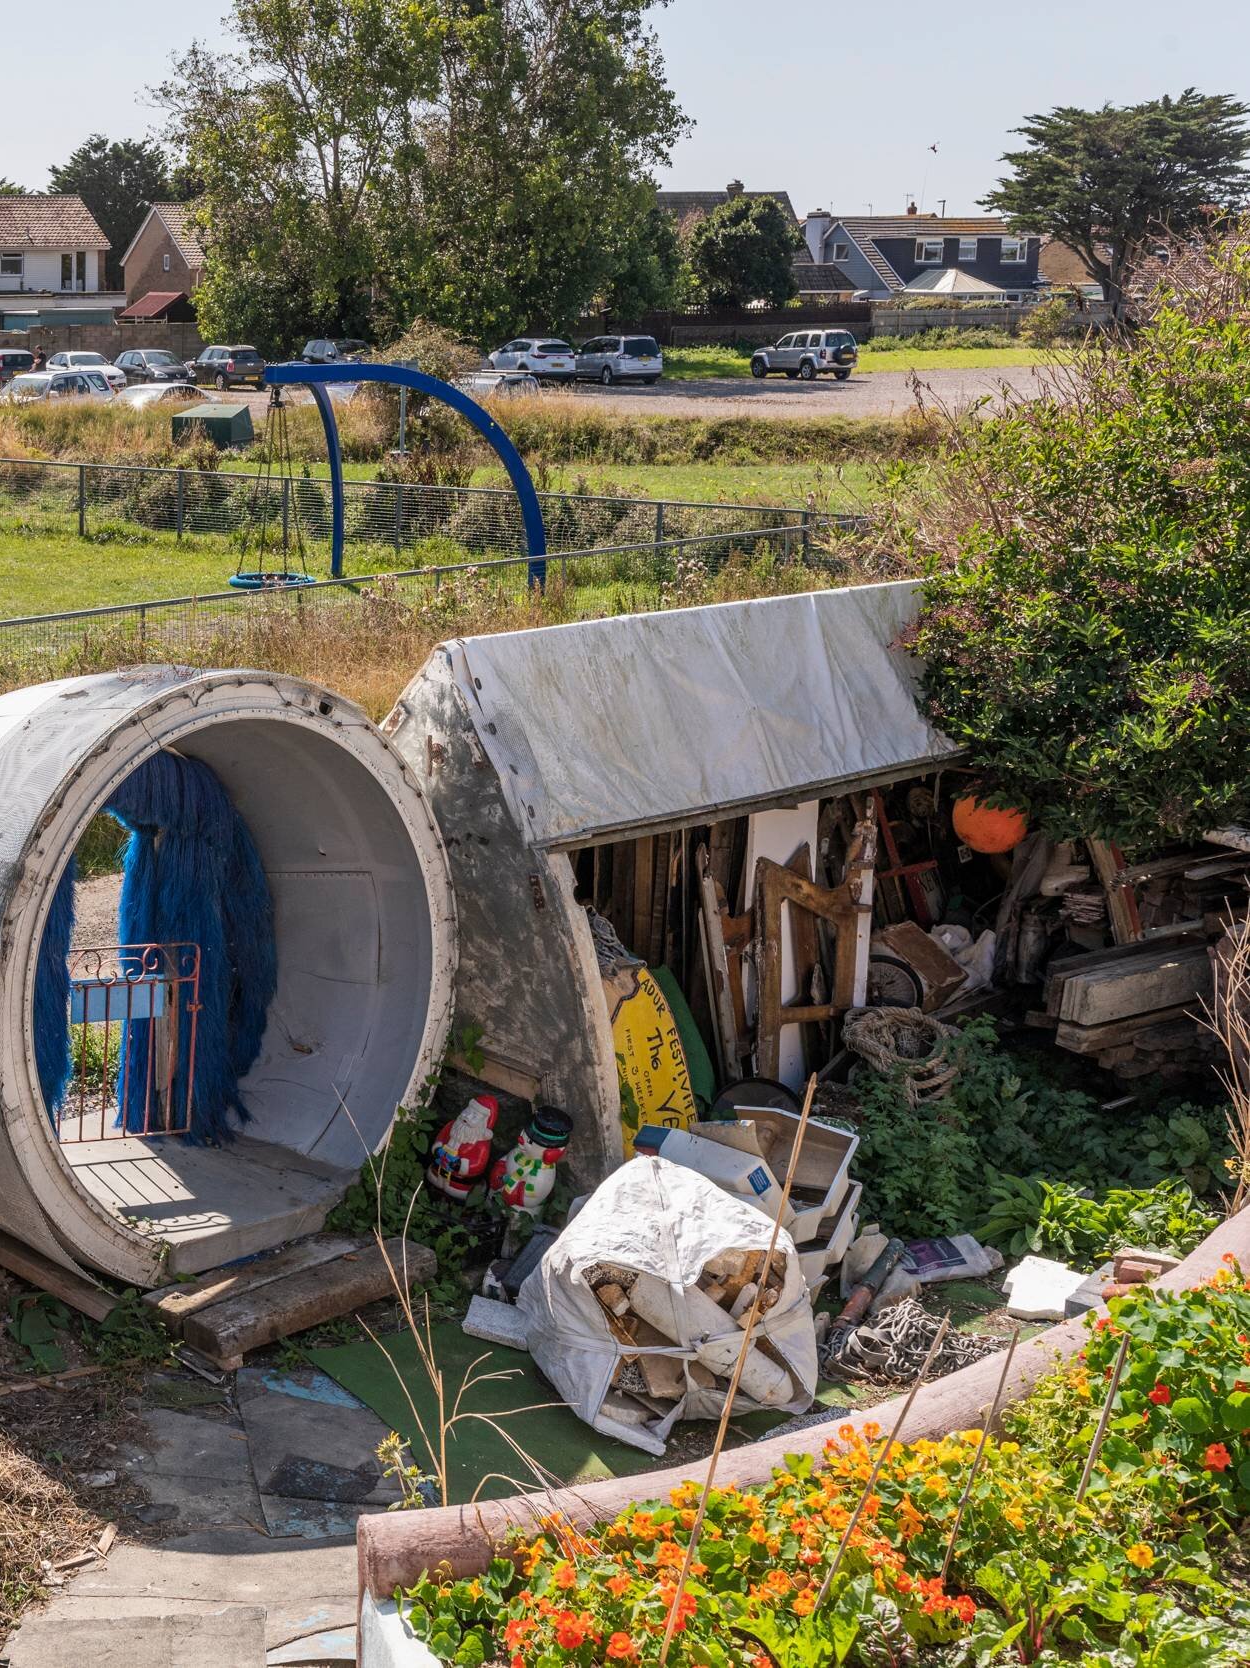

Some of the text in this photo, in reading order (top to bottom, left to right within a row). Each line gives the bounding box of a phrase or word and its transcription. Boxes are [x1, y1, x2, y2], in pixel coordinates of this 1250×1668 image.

[640, 978, 666, 1018] ADUR
[625, 1028, 636, 1057] FIRST
[631, 1065, 639, 1076] 3
[643, 1070, 654, 1098] OPEN
